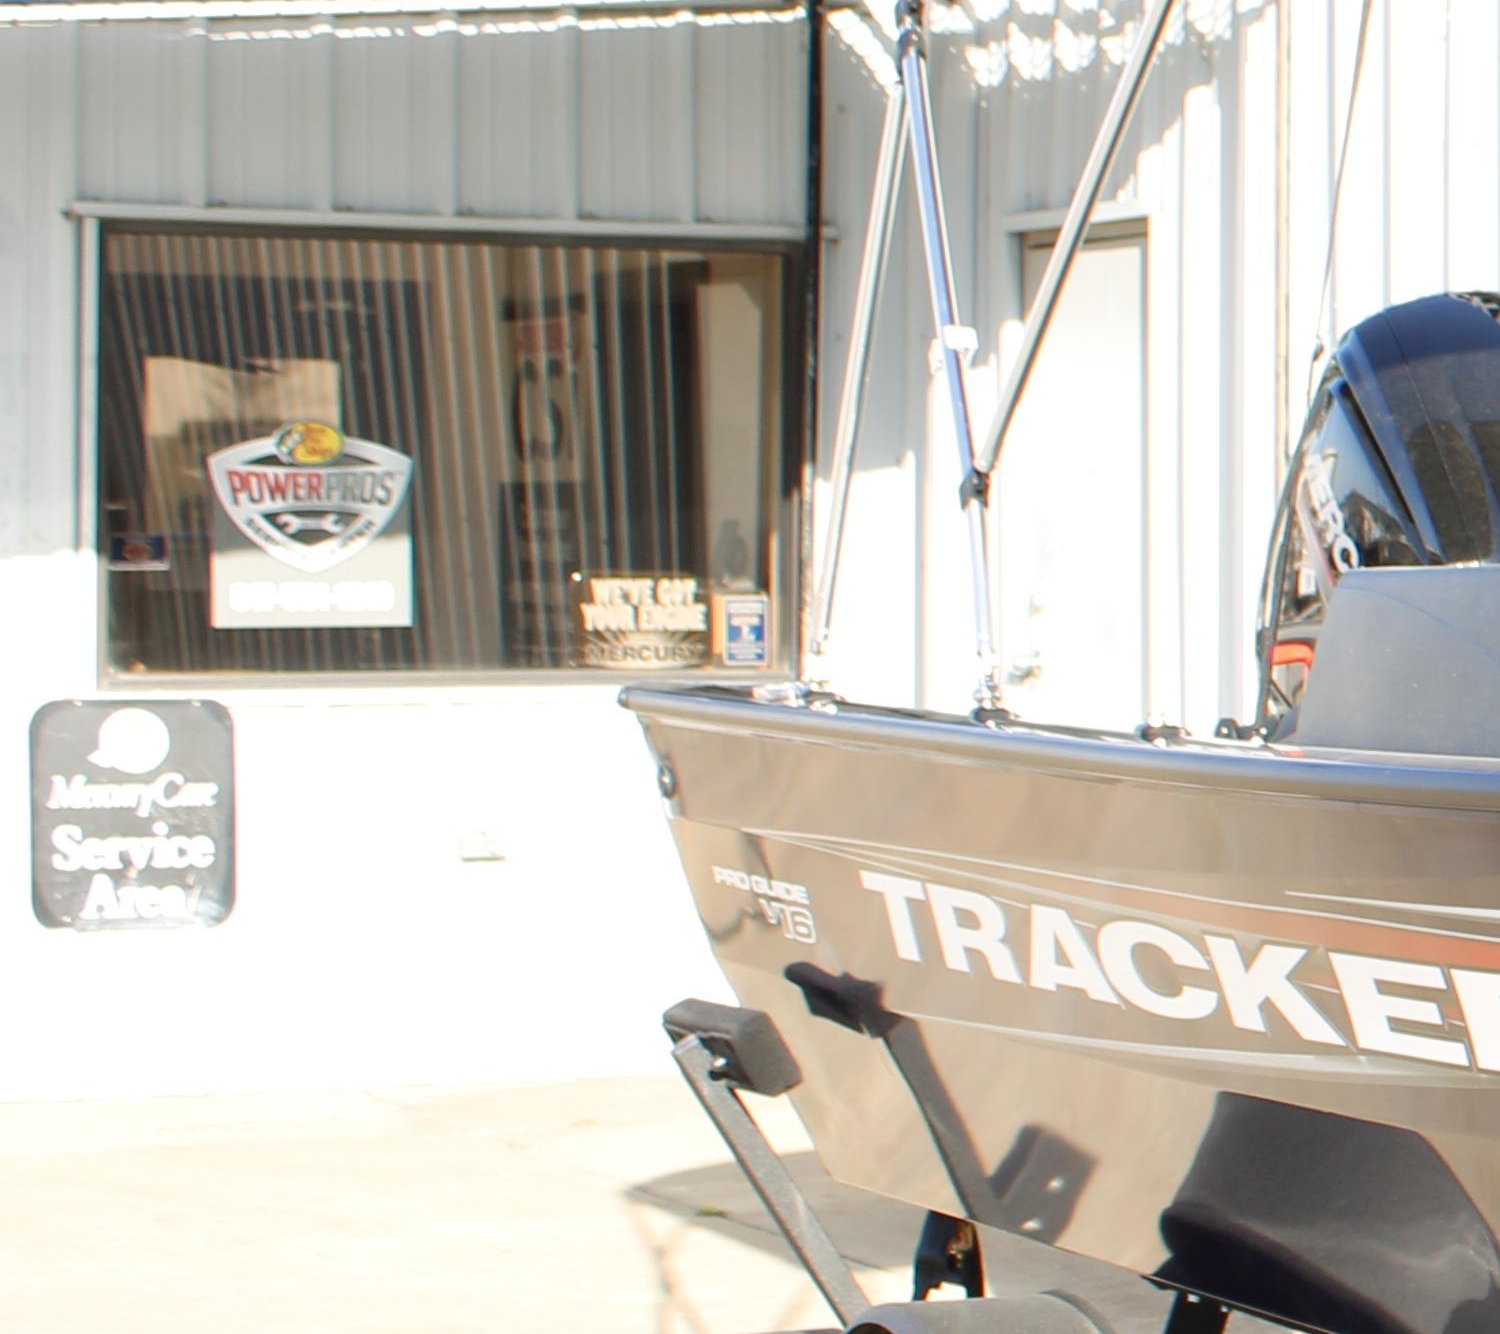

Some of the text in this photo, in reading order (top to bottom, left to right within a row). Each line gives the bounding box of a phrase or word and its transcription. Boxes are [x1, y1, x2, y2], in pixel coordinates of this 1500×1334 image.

[584, 644, 705, 663] MERCURY
[50, 820, 218, 872] Service
[78, 872, 188, 920] Area
[711, 865, 810, 905] PRO GUIDE
